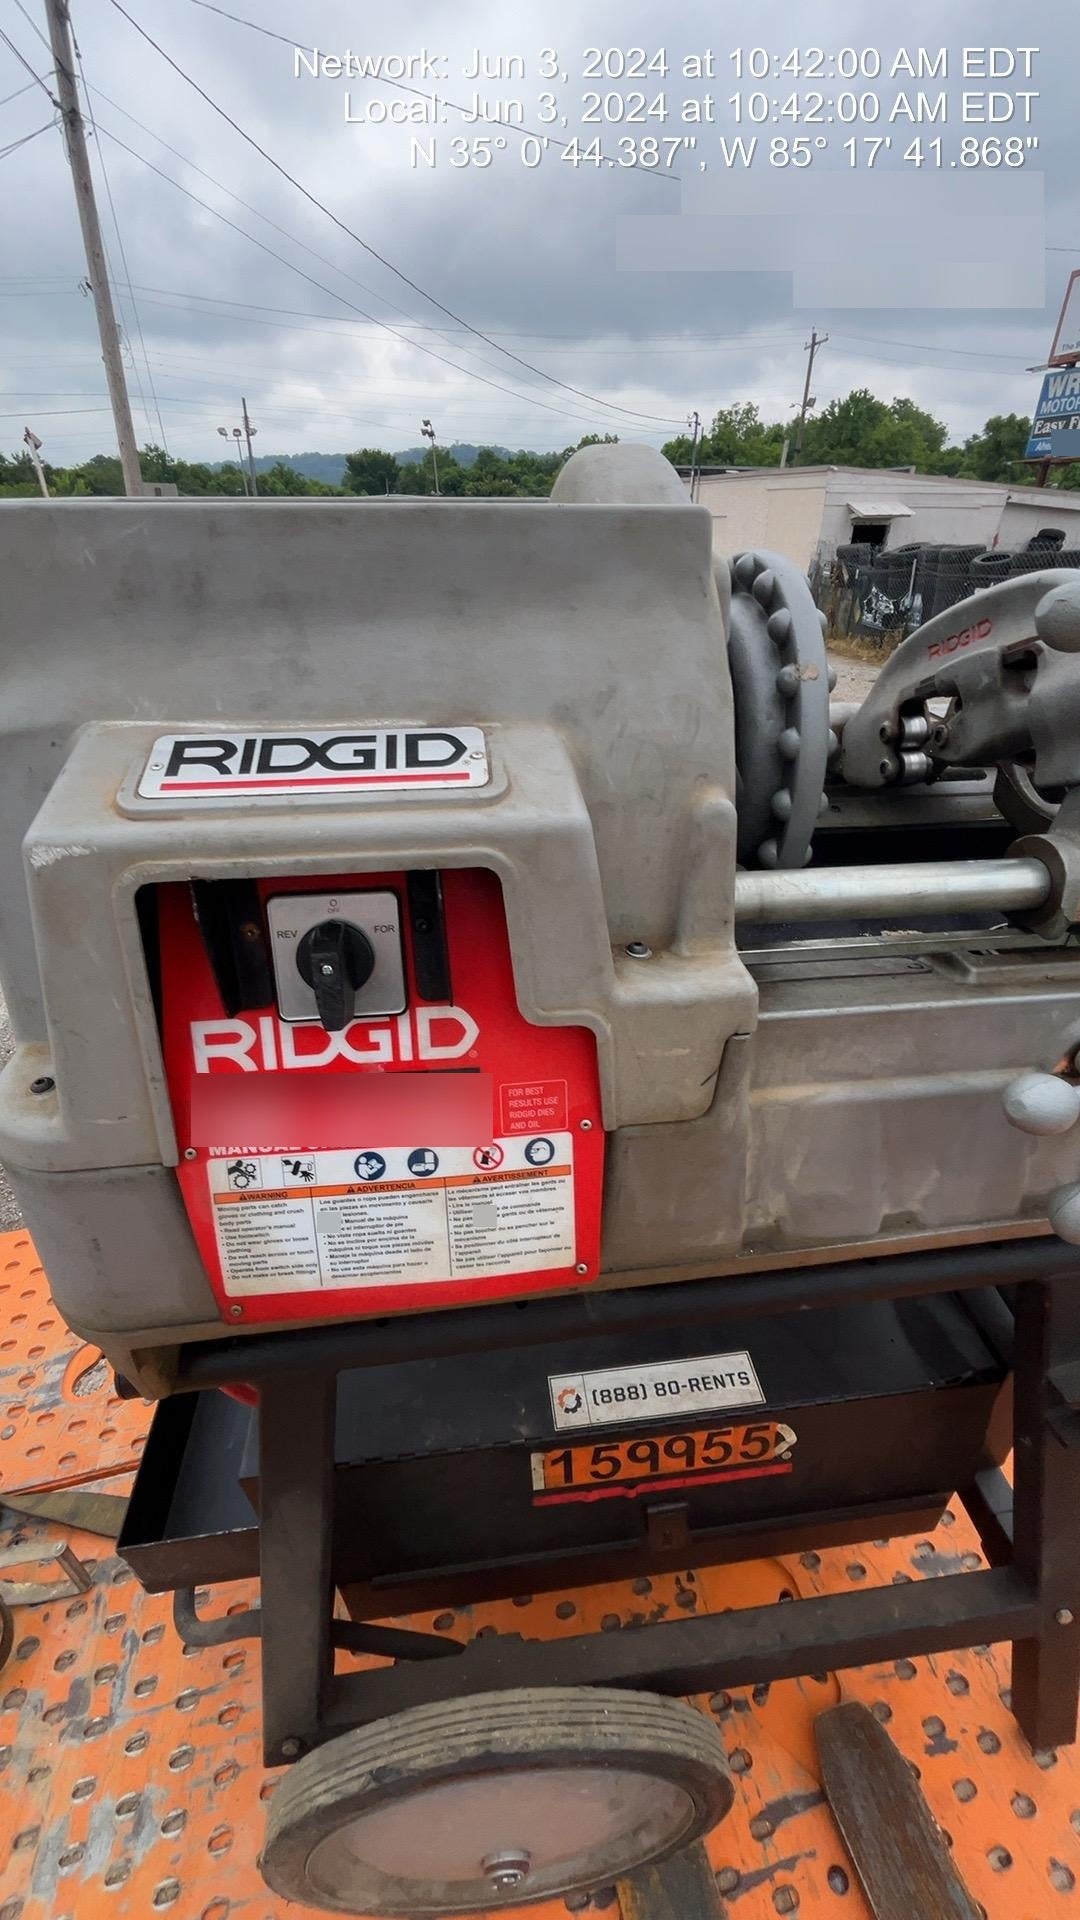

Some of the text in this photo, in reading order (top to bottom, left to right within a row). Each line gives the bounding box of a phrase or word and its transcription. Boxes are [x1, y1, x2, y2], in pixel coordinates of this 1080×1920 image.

[927, 618, 993, 662] RIDGID
[164, 732, 468, 777] RIDGID
[277, 930, 298, 939] REV
[374, 924, 396, 934] FOR
[190, 1005, 480, 1074] RIDGID
[508, 1086, 544, 1097] FOR BEST
[509, 1096, 559, 1108] RESULTS USE
[509, 1107, 555, 1119] RIDGID DIES
[510, 1120, 541, 1130] AND OIL
[482, 1170, 548, 1183] AVERTISSEMENT
[356, 1182, 416, 1193] ADVERTENCIA
[246, 1191, 288, 1201] WARNING
[591, 1371, 750, 1407] (888) 80-RENTS
[550, 1425, 771, 1484] 159955
